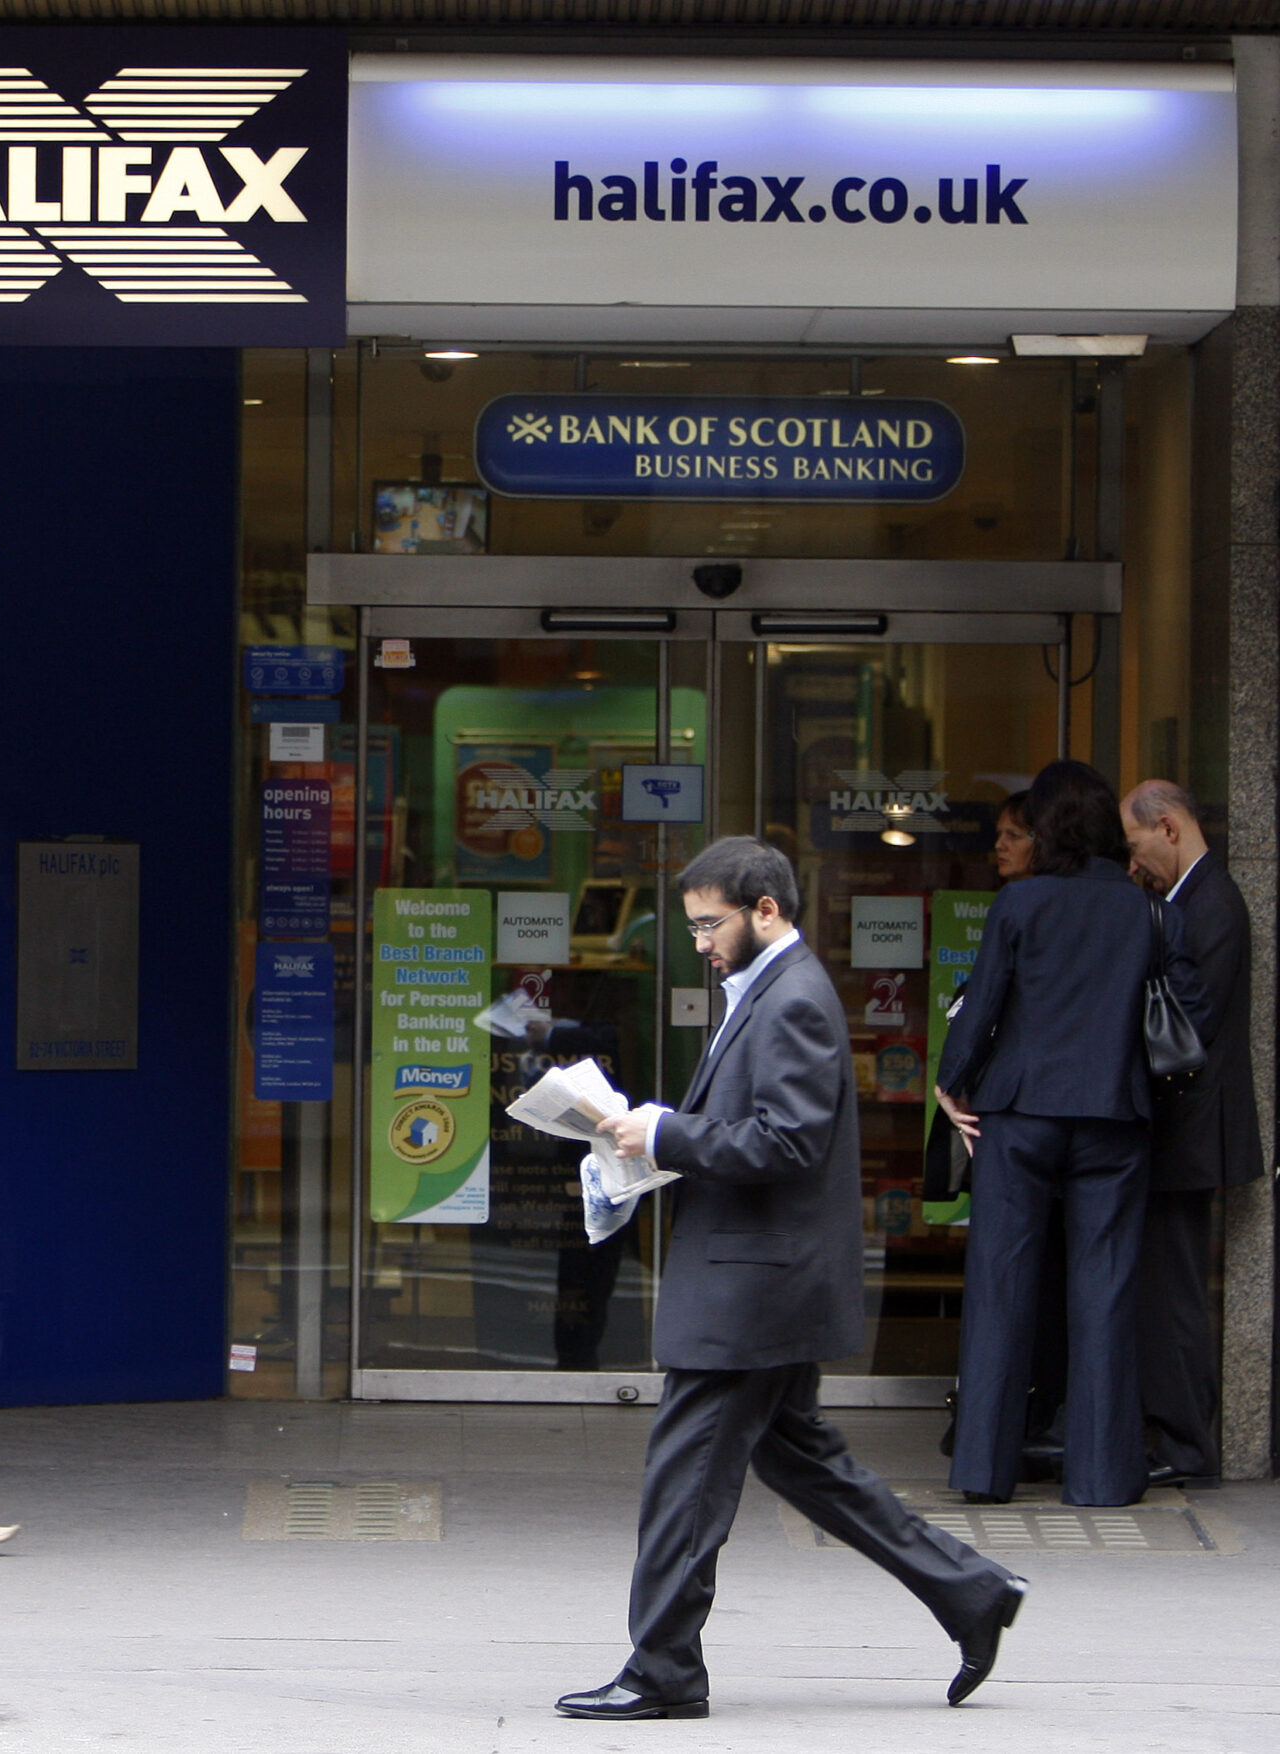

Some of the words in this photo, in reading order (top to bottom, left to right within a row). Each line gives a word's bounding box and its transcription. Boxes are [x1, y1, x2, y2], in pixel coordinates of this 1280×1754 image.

[553, 157, 1029, 224] halifax.co.uk
[559, 415, 661, 446] BANK
[668, 416, 719, 446] OF
[728, 417, 933, 449] SCOTLAND
[634, 455, 779, 479] BUSINESS
[793, 457, 933, 481] BANKING
[264, 786, 330, 805] opening
[475, 790, 598, 811] HALIFAX
[830, 791, 951, 812] HALIFAX
[264, 805, 312, 820] hours
[39, 853, 96, 874] HALIFAX
[99, 854, 120, 877] plc
[395, 900, 471, 916] Welcome
[953, 902, 989, 919] Welc
[503, 917, 564, 926] AUTOMATIC
[857, 921, 918, 931] AUTOMATIC
[408, 924, 424, 938] to
[430, 923, 458, 938] the
[517, 930, 549, 938] DOOR
[872, 934, 903, 943] DOOR
[966, 927, 983, 942] to
[380, 945, 419, 962] Best
[424, 945, 485, 962] Branch
[938, 947, 977, 964] Best
[274, 962, 315, 971] HALIFAX
[395, 968, 470, 985] Network
[381, 991, 406, 1007] for
[410, 991, 482, 1007] Personal
[937, 993, 952, 1009] fo
[397, 1014, 466, 1033] Banking
[393, 1037, 409, 1052] in
[415, 1037, 441, 1052] the
[447, 1037, 470, 1052] UK
[401, 1067, 464, 1088] Money
[395, 1109, 414, 1132] DIRECT
[413, 1103, 445, 1116] AWARDS
